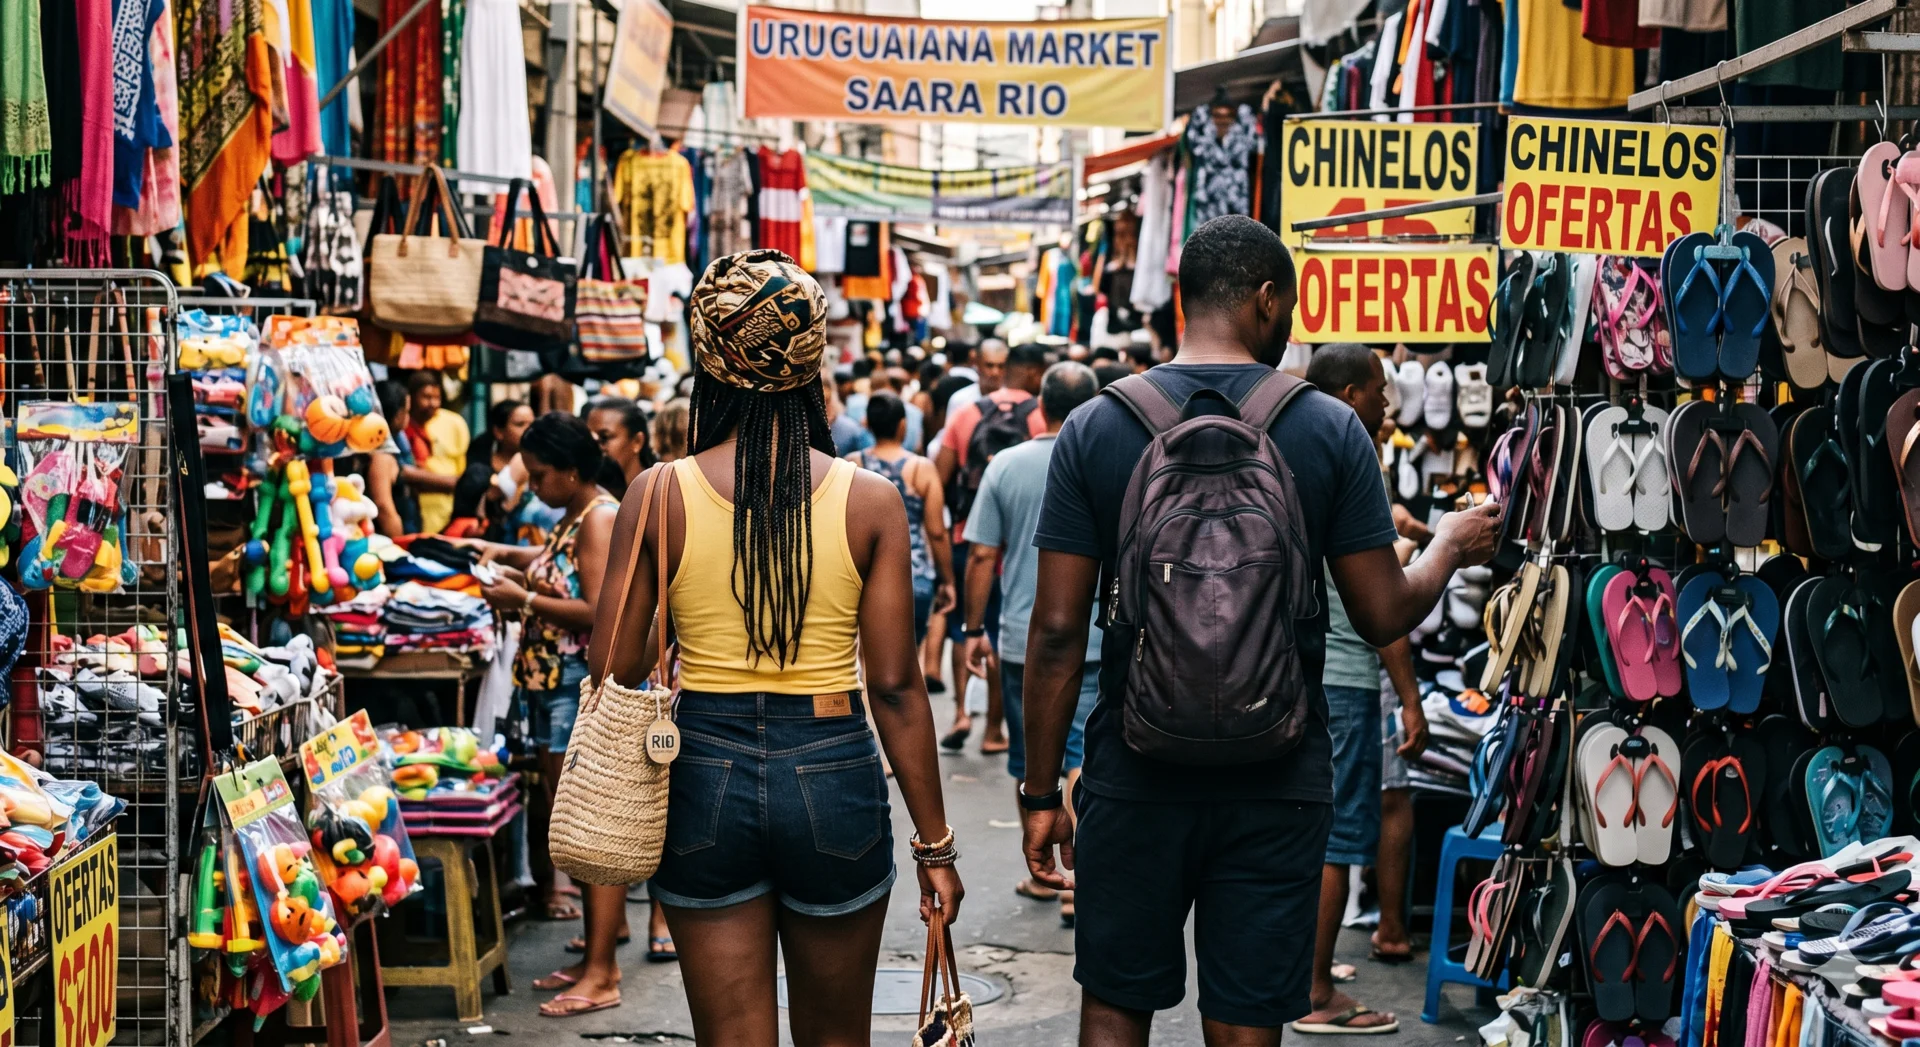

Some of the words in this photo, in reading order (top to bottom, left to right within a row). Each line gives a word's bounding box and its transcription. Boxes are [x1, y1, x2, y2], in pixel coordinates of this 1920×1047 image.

[752, 23, 994, 62] URUGUAIANA
[1008, 31, 1159, 66] MARKET
[846, 79, 982, 114] SAARA
[998, 83, 1066, 116] RIO
[1288, 125, 1472, 192] CHINELOS
[1510, 123, 1718, 182] CHINELOS
[1506, 182, 1693, 253] OFERTAS
[1299, 257, 1491, 333] OFERTAS
[652, 734, 675, 749] RIO
[53, 843, 115, 944] OFERTAS
